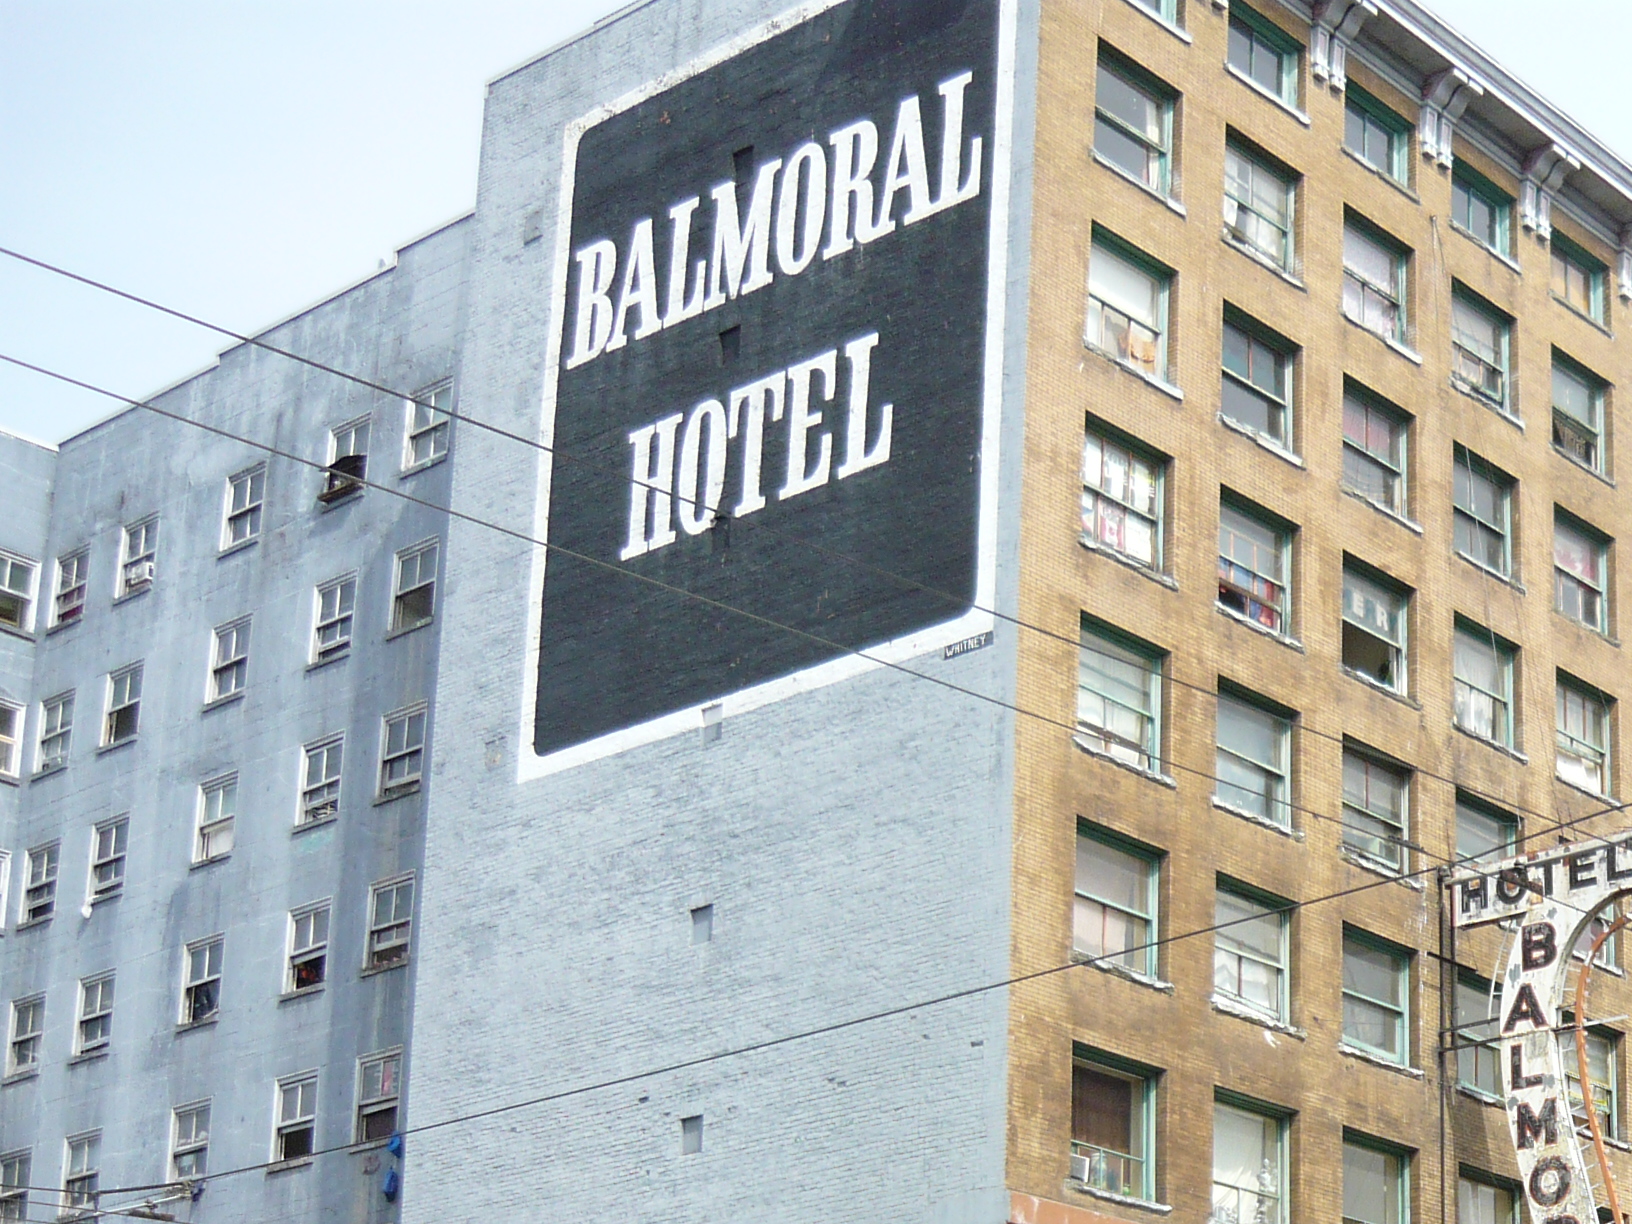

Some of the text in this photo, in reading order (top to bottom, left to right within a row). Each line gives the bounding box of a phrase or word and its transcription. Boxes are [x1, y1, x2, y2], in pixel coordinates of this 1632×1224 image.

[566, 72, 983, 370] BALMORAL
[620, 333, 893, 561] HOTEL
[945, 633, 986, 657] WHITNEY
